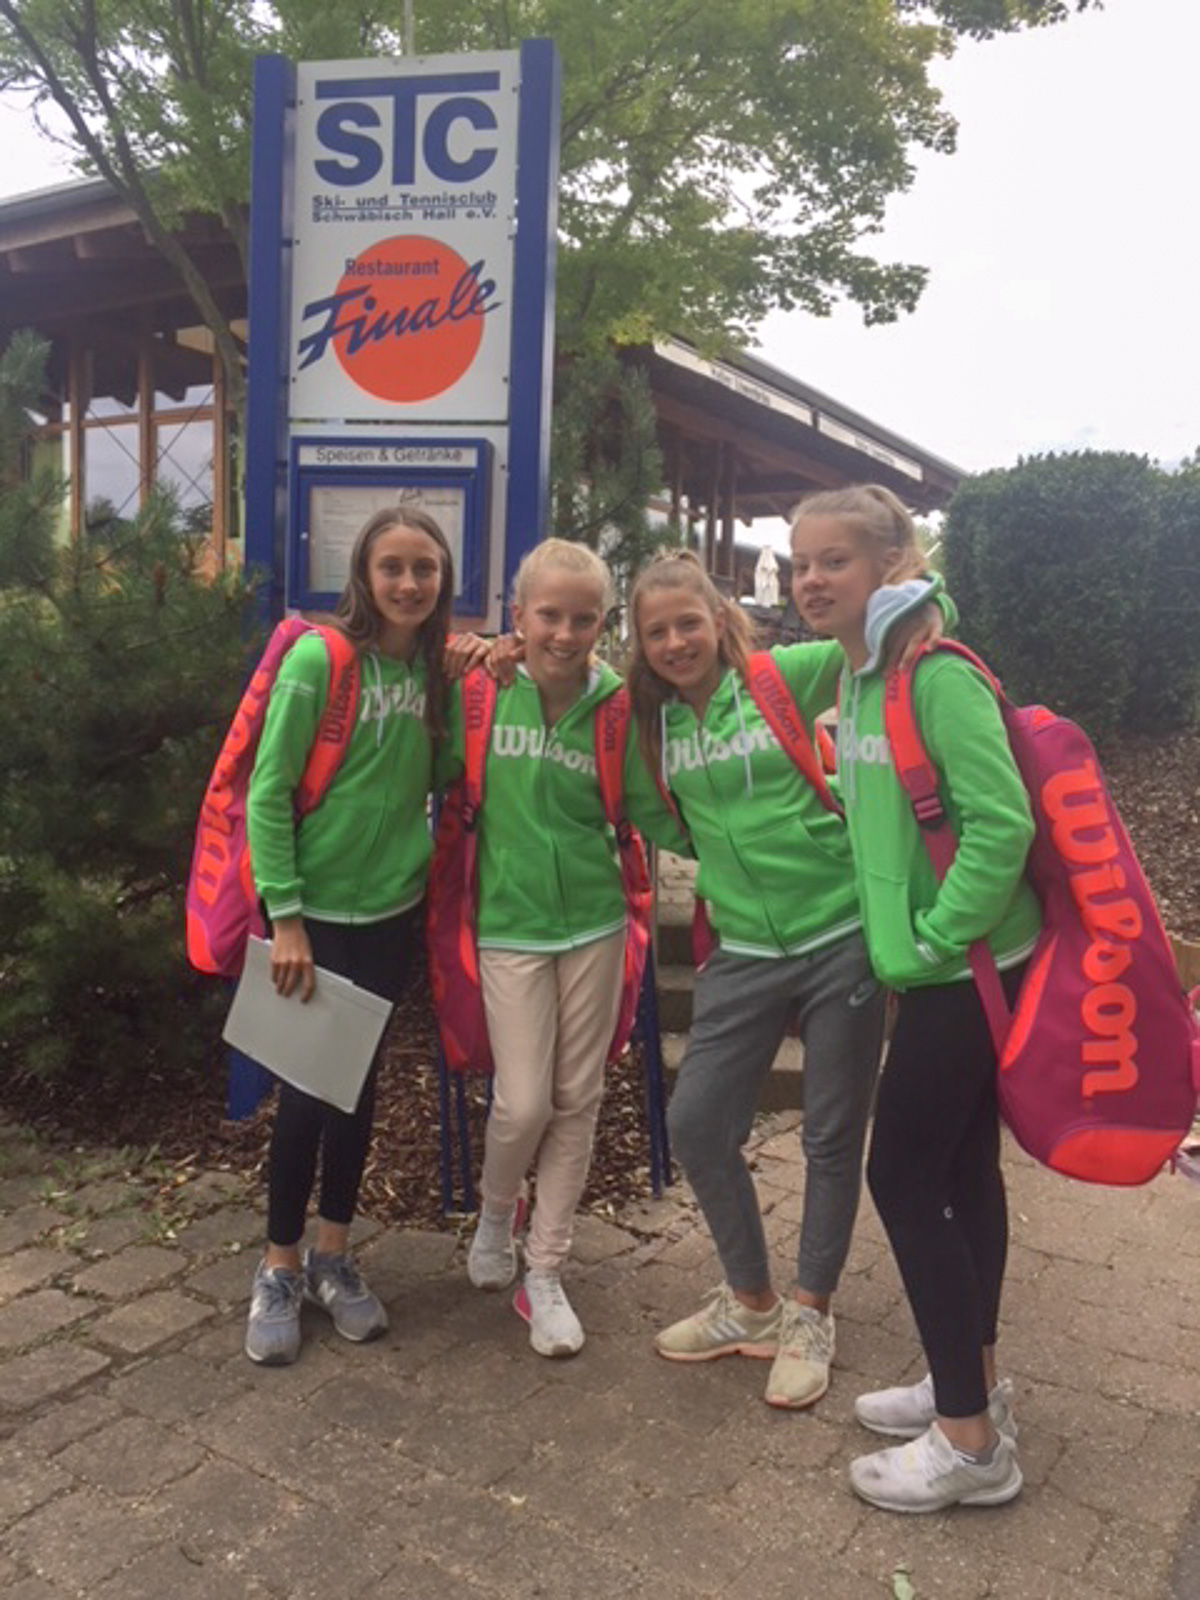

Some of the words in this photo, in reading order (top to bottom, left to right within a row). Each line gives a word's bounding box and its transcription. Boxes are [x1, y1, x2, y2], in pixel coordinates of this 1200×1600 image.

[314, 70, 500, 187] STC
[312, 193, 346, 207] Ski-
[356, 194, 389, 206] und
[399, 190, 497, 206] Tennisclub
[312, 209, 413, 222] Schwäbisch
[422, 209, 456, 220] Hall
[465, 207, 497, 219] e.V.
[344, 257, 441, 275] Restaurant
[297, 259, 503, 371] Finale
[316, 447, 374, 465] Speisen
[377, 449, 388, 462] &
[1040, 758, 1140, 1097] Wilson
